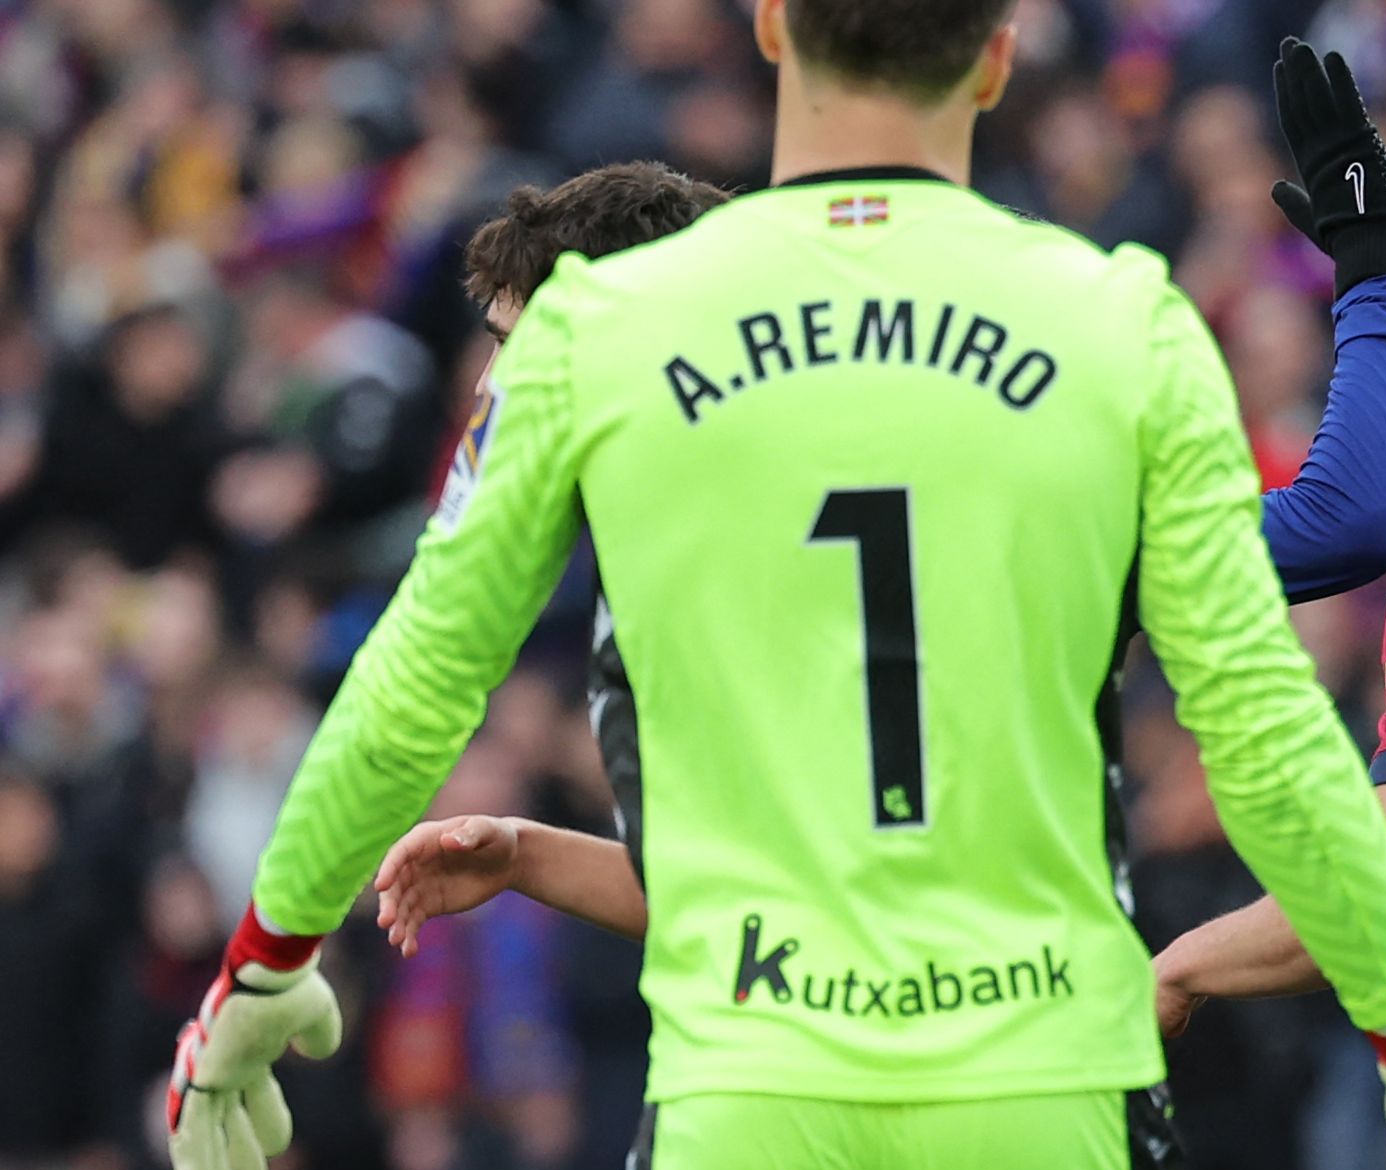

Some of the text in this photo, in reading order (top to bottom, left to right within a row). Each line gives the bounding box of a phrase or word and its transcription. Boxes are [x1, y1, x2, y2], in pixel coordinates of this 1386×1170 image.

[661, 298, 1059, 425] A.REMIRO
[804, 485, 924, 826] 1
[735, 914, 1073, 1018] Kutxabank
